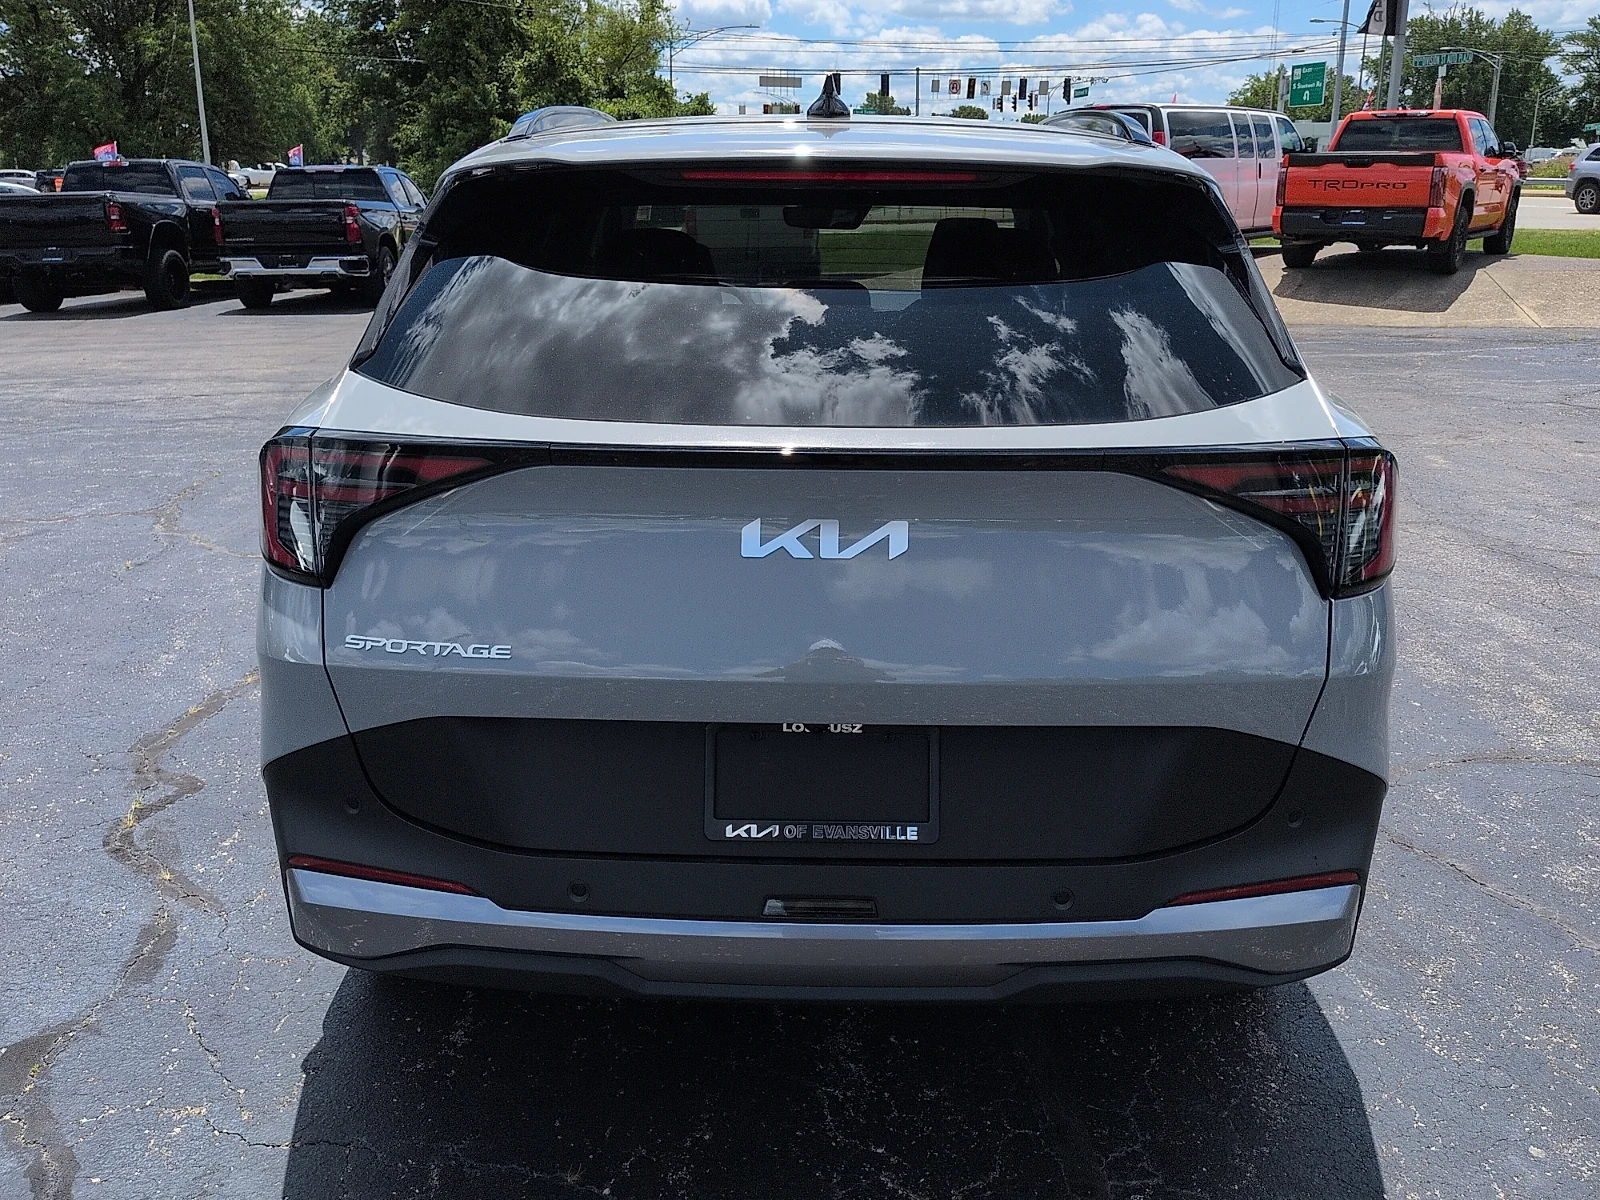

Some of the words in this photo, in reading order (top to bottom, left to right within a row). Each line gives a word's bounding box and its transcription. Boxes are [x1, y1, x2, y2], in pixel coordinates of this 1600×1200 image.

[1308, 179, 1359, 191] TRD
[1360, 182, 1407, 190] PRO
[741, 518, 909, 560] KIA
[344, 634, 512, 659] SPORTAGE
[725, 823, 779, 838] KIA
[783, 824, 807, 839] OF
[812, 825, 919, 841] EVANSVILLE
